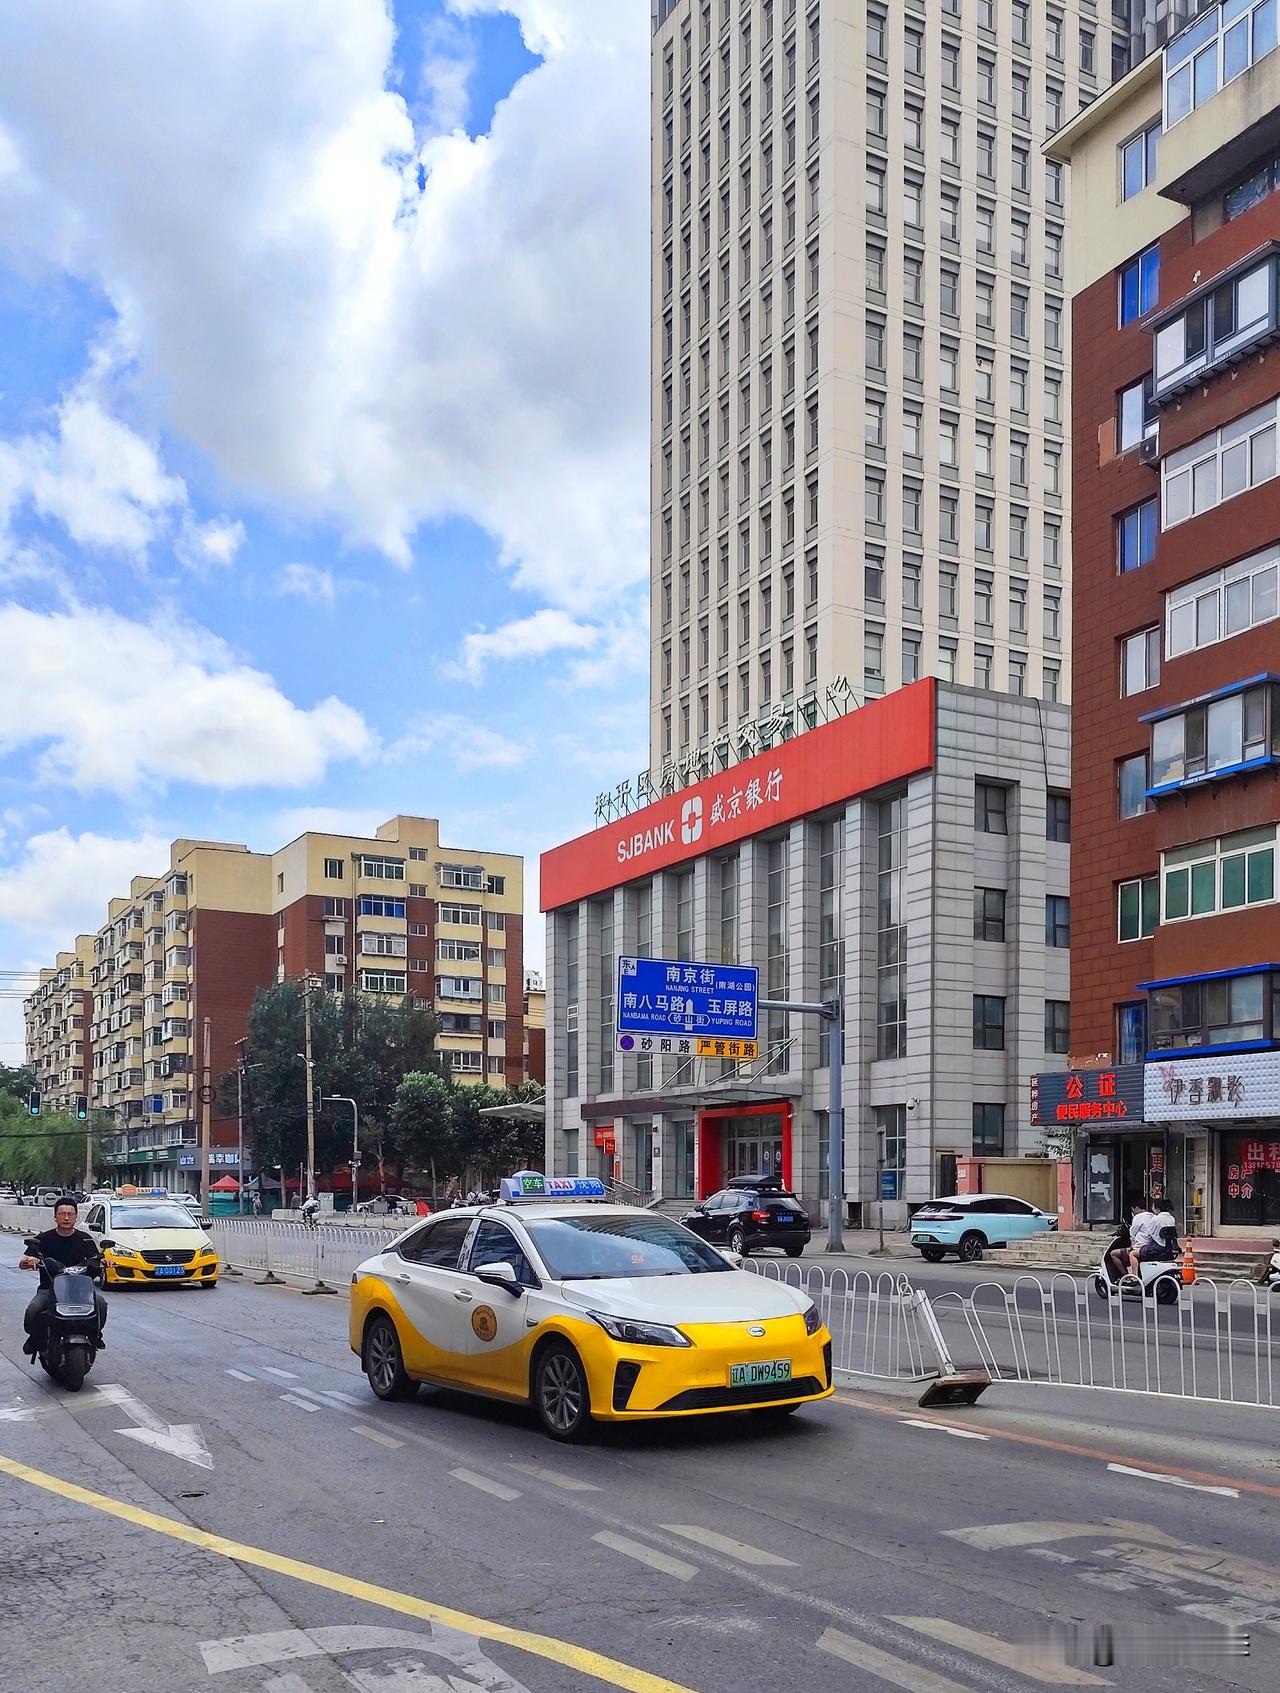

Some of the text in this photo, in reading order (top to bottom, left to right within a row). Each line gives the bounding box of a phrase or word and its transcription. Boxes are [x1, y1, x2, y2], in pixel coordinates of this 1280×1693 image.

[617, 819, 676, 863] SJBANK
[666, 966, 715, 985] 南京街
[666, 985, 714, 994] NANJING STREET
[623, 992, 685, 1012] 南八马路
[707, 999, 753, 1017] 玉屏路
[623, 1012, 667, 1021] NANBAMA ROAD
[673, 1014, 705, 1025] 砂山街
[712, 1018, 733, 1026] YUPING
[641, 1037, 690, 1053] 砂阳路
[699, 1040, 755, 1056] 严管街路
[1066, 1073, 1116, 1099] 公证
[1056, 1099, 1128, 1121] 便民服务中心
[523, 1178, 543, 1189] 空车
[546, 1180, 573, 1189] TAXI
[577, 1180, 601, 1189] 沈阳
[1228, 1182, 1254, 1199] 中介
